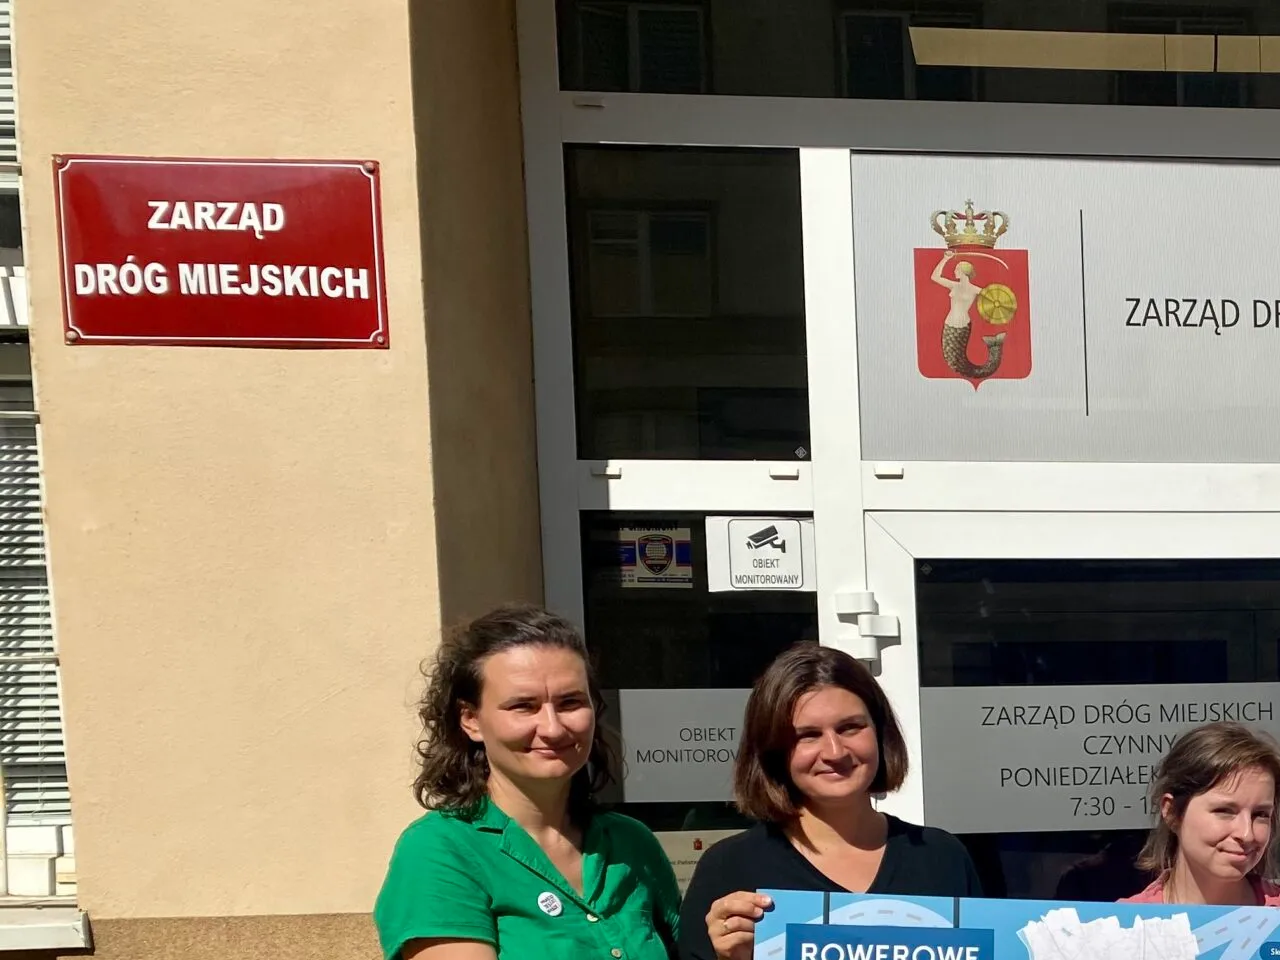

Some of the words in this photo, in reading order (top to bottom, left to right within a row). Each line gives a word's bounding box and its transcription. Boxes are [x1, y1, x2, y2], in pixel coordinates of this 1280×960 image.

[146, 200, 285, 240] ZARZĄD
[74, 255, 168, 296] DRÓG
[179, 263, 370, 300] MIEJSKICH
[1125, 298, 1240, 335] ZARZĄD
[752, 558, 780, 568] OBIEKT
[735, 574, 799, 585] MONITOROWANY
[981, 705, 1076, 731] ZARZĄD
[1085, 699, 1151, 725] DRÓG
[1160, 702, 1274, 724] MIEJSKICH
[679, 727, 737, 742] OBIEKT
[1083, 734, 1177, 755] CZYNNY
[1070, 796, 1116, 817] 7:30
